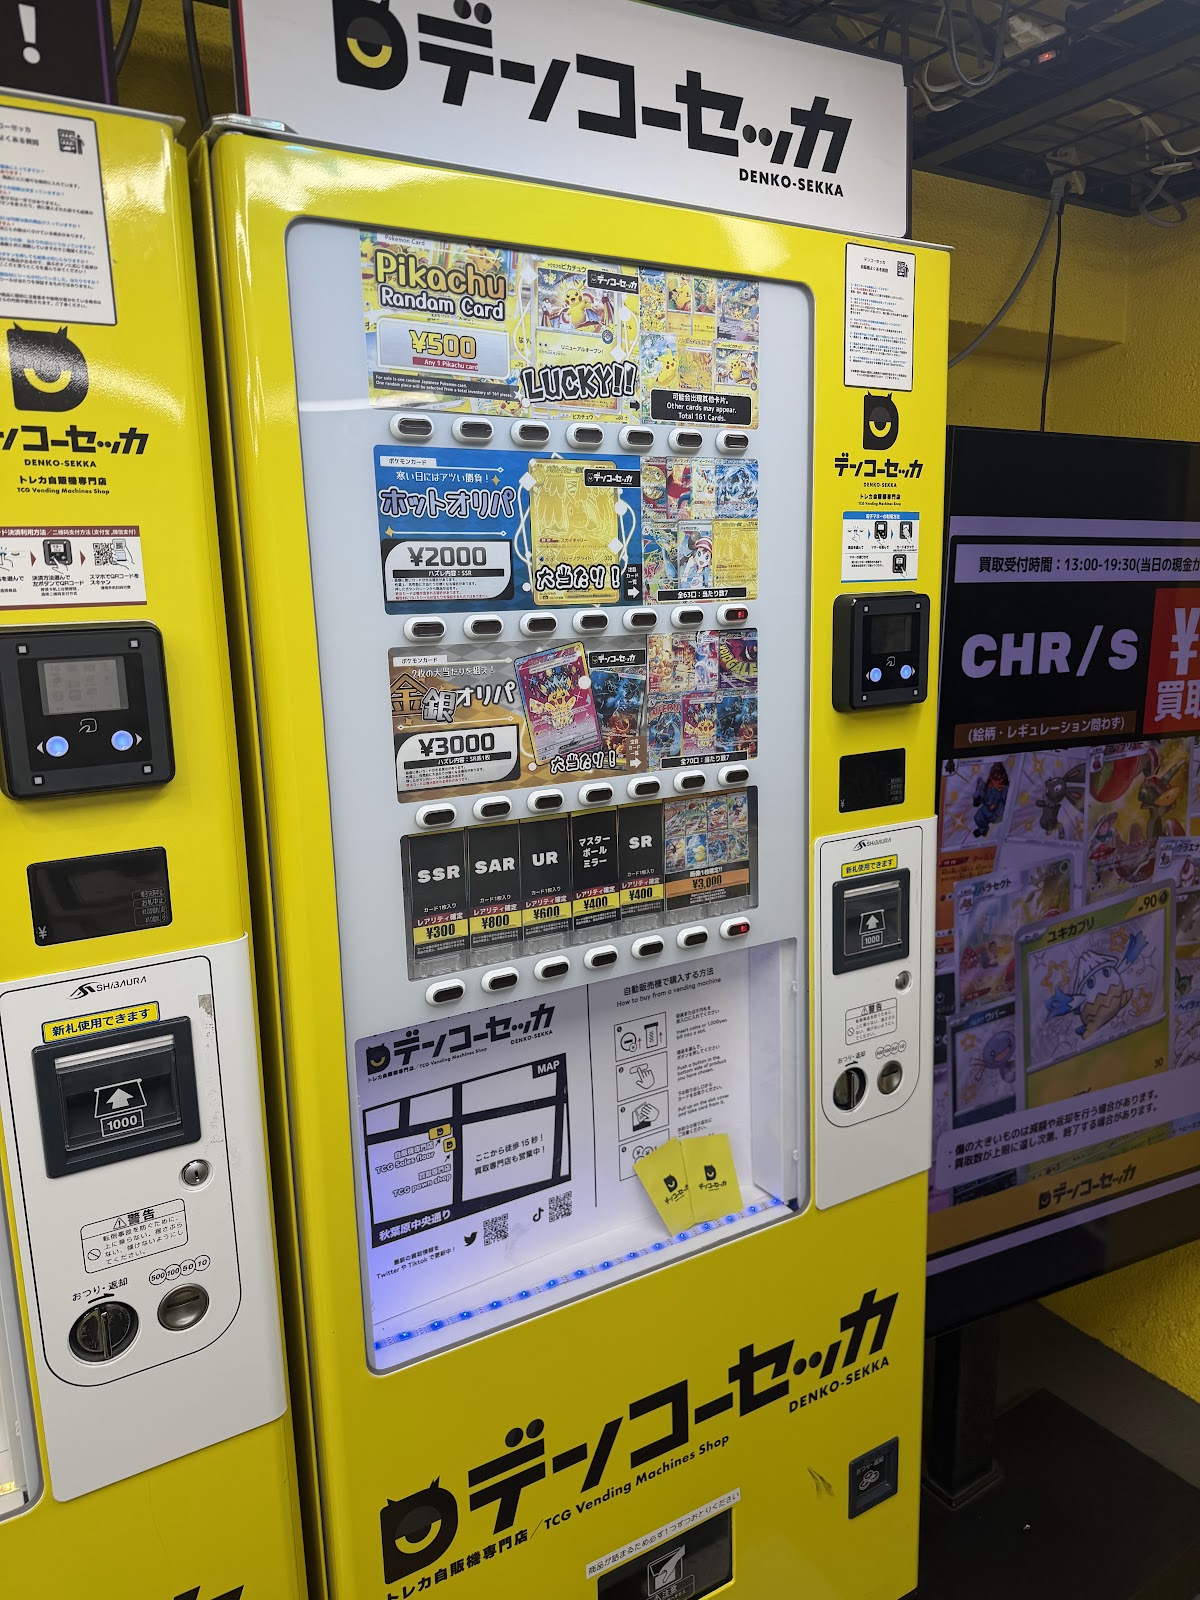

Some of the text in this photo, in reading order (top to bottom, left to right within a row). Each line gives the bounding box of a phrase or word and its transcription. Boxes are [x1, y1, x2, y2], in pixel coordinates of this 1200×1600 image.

[417, 0, 852, 174] デンコーセッカ
[739, 168, 844, 197] DENKO-SEKKA
[385, 234, 410, 243] Pokemon
[375, 248, 507, 300] Pikachu
[378, 283, 505, 322] Randam Card
[409, 329, 477, 359] ¥500
[442, 361, 465, 369] Pikachu
[521, 360, 638, 403] LUCKY!!
[667, 402, 684, 410] Other
[686, 403, 702, 411] cards
[716, 406, 736, 414] appear.
[678, 412, 693, 420] Total
[707, 414, 726, 422] Cards.
[24, 459, 96, 467] DENKO-SEKKA
[834, 452, 923, 478] デンコーセッカ
[20, 476, 106, 485] トレカ自販機専門店
[379, 485, 516, 519] ホットオリパ
[407, 546, 487, 567] ¥2000
[536, 564, 620, 590] 大当たり！
[402, 656, 438, 664] ポケモンカード
[968, 716, 1124, 743] (絵柄・レギュレーション問わず)
[418, 732, 495, 757] ¥3000
[550, 750, 617, 774] 大当たり！
[579, 835, 611, 847] マスター
[629, 834, 652, 850] SR
[532, 851, 558, 867] UR
[582, 847, 607, 857] ボール
[475, 857, 515, 874] SAR
[583, 858, 607, 868] ミラー
[846, 859, 893, 874] 新札使用できます
[417, 865, 460, 883] SSR
[693, 875, 722, 889] ¥3,000
[622, 877, 660, 889] レアリティ確定
[576, 885, 616, 899] レアリティ確定
[629, 887, 653, 900] ¥400
[473, 903, 518, 916] レアリティ確定
[526, 895, 567, 909] レアリティ確定
[584, 896, 608, 911] ¥400
[1142, 893, 1157, 910] 90
[417, 912, 463, 927] レアリティ確定
[533, 905, 560, 920] ¥600
[481, 914, 509, 930] ¥800
[38, 926, 47, 939] ¥
[426, 923, 456, 939] ¥300
[1047, 918, 1095, 944] ユキカブリ
[865, 935, 880, 945] 1000
[97, 976, 147, 991] SHIBAURA
[624, 967, 714, 996] 自動販売機で購入する方法
[673, 983, 695, 993] vending
[697, 978, 721, 987] machine
[52, 1008, 150, 1037] 新札使用できます
[393, 1003, 555, 1066] デンコーセッカ
[510, 1029, 553, 1045] DENKO-SEKKA
[537, 1060, 560, 1075] MAP
[677, 1068, 693, 1076] bottom
[709, 1059, 726, 1068] product
[1154, 1057, 1164, 1068] 30
[107, 1115, 138, 1130] 1000
[375, 1151, 435, 1174] TCG Sales floor
[474, 1145, 545, 1175] 買取専門店も営業中！
[392, 1174, 452, 1197] TCG pawn shop
[1054, 1164, 1136, 1204] デンコーセッカ
[128, 1208, 154, 1226] 警告
[379, 1209, 451, 1241] 秋葉原中央通り
[151, 1272, 165, 1281] 500
[167, 1268, 180, 1276] 100
[376, 1257, 428, 1279] Twitter Tiktok
[72, 1277, 128, 1301] おつり・返却
[787, 1355, 890, 1413] DENKO-SEKKA
[467, 1288, 899, 1536] デンコーセッカ
[544, 1509, 572, 1530] TCG
[575, 1482, 631, 1514] Vending
[635, 1451, 695, 1486] Machines
[698, 1435, 730, 1456] Shop
[588, 1492, 740, 1575] 商品が詰まるため必ず1つずつおとりください
